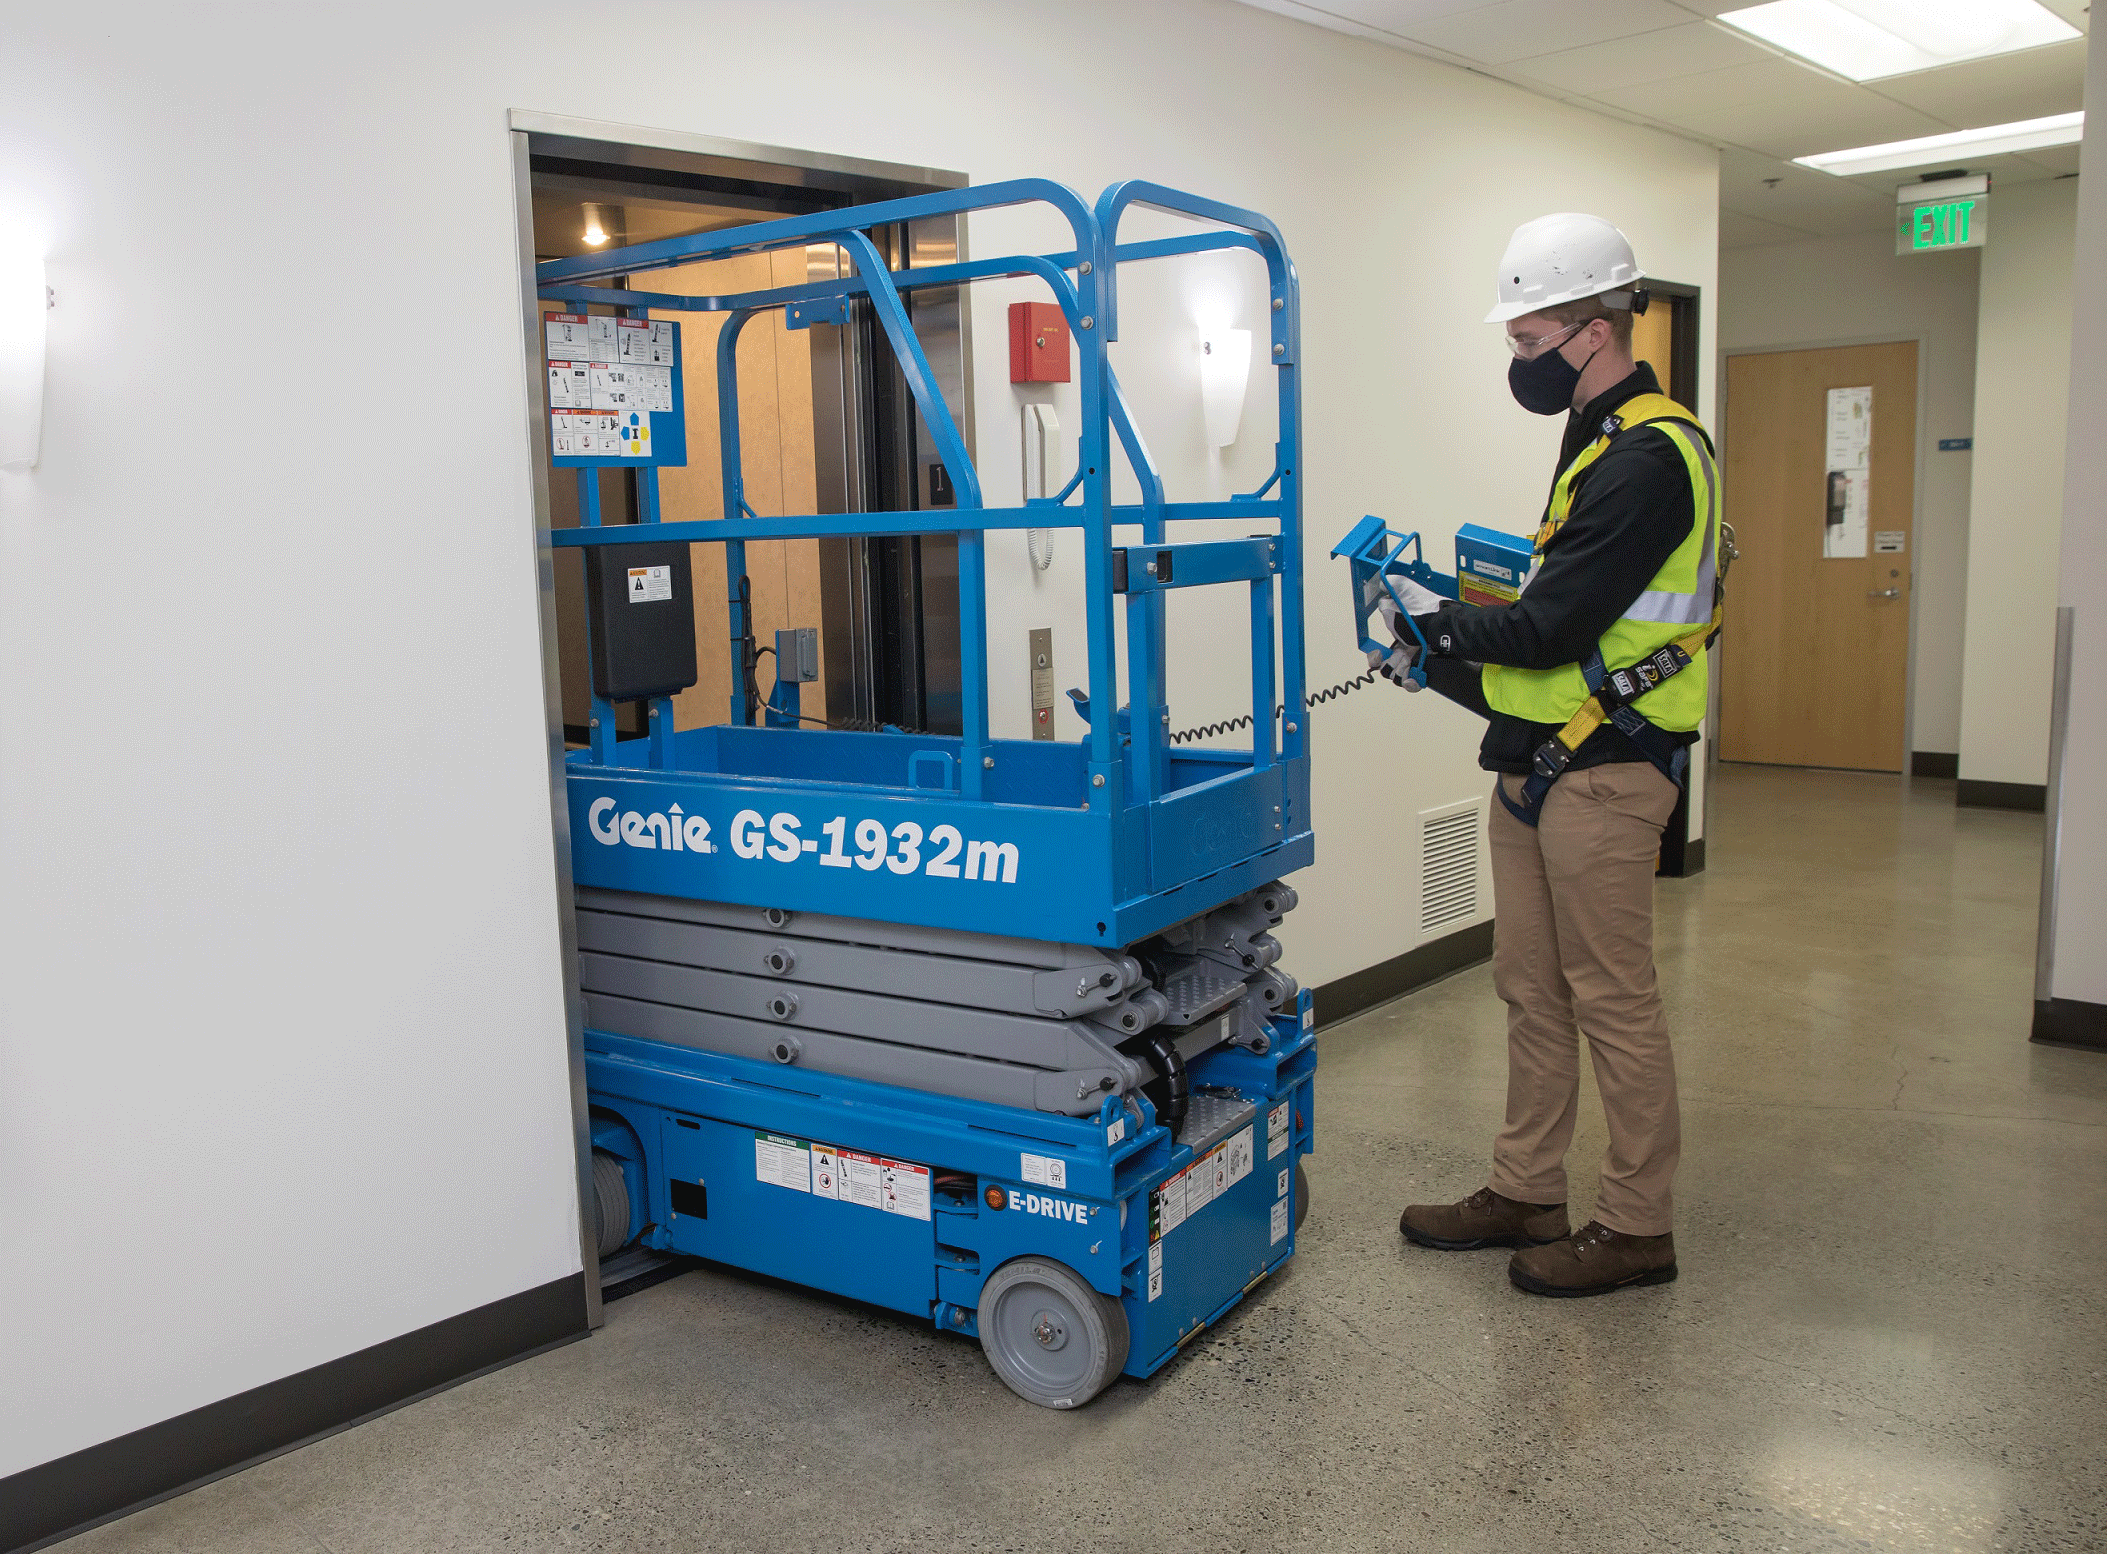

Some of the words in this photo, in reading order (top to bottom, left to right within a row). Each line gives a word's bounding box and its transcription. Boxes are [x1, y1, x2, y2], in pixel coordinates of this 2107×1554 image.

[1914, 201, 1975, 248] EXIT
[936, 466, 944, 492] 1
[1659, 655, 1672, 673] SALA
[1617, 674, 1630, 693] SALA
[589, 797, 712, 854] Genie
[730, 809, 1020, 883] GS-1932m
[852, 1153, 872, 1163] DANGER
[1009, 1190, 1088, 1225] E-DRIVE
